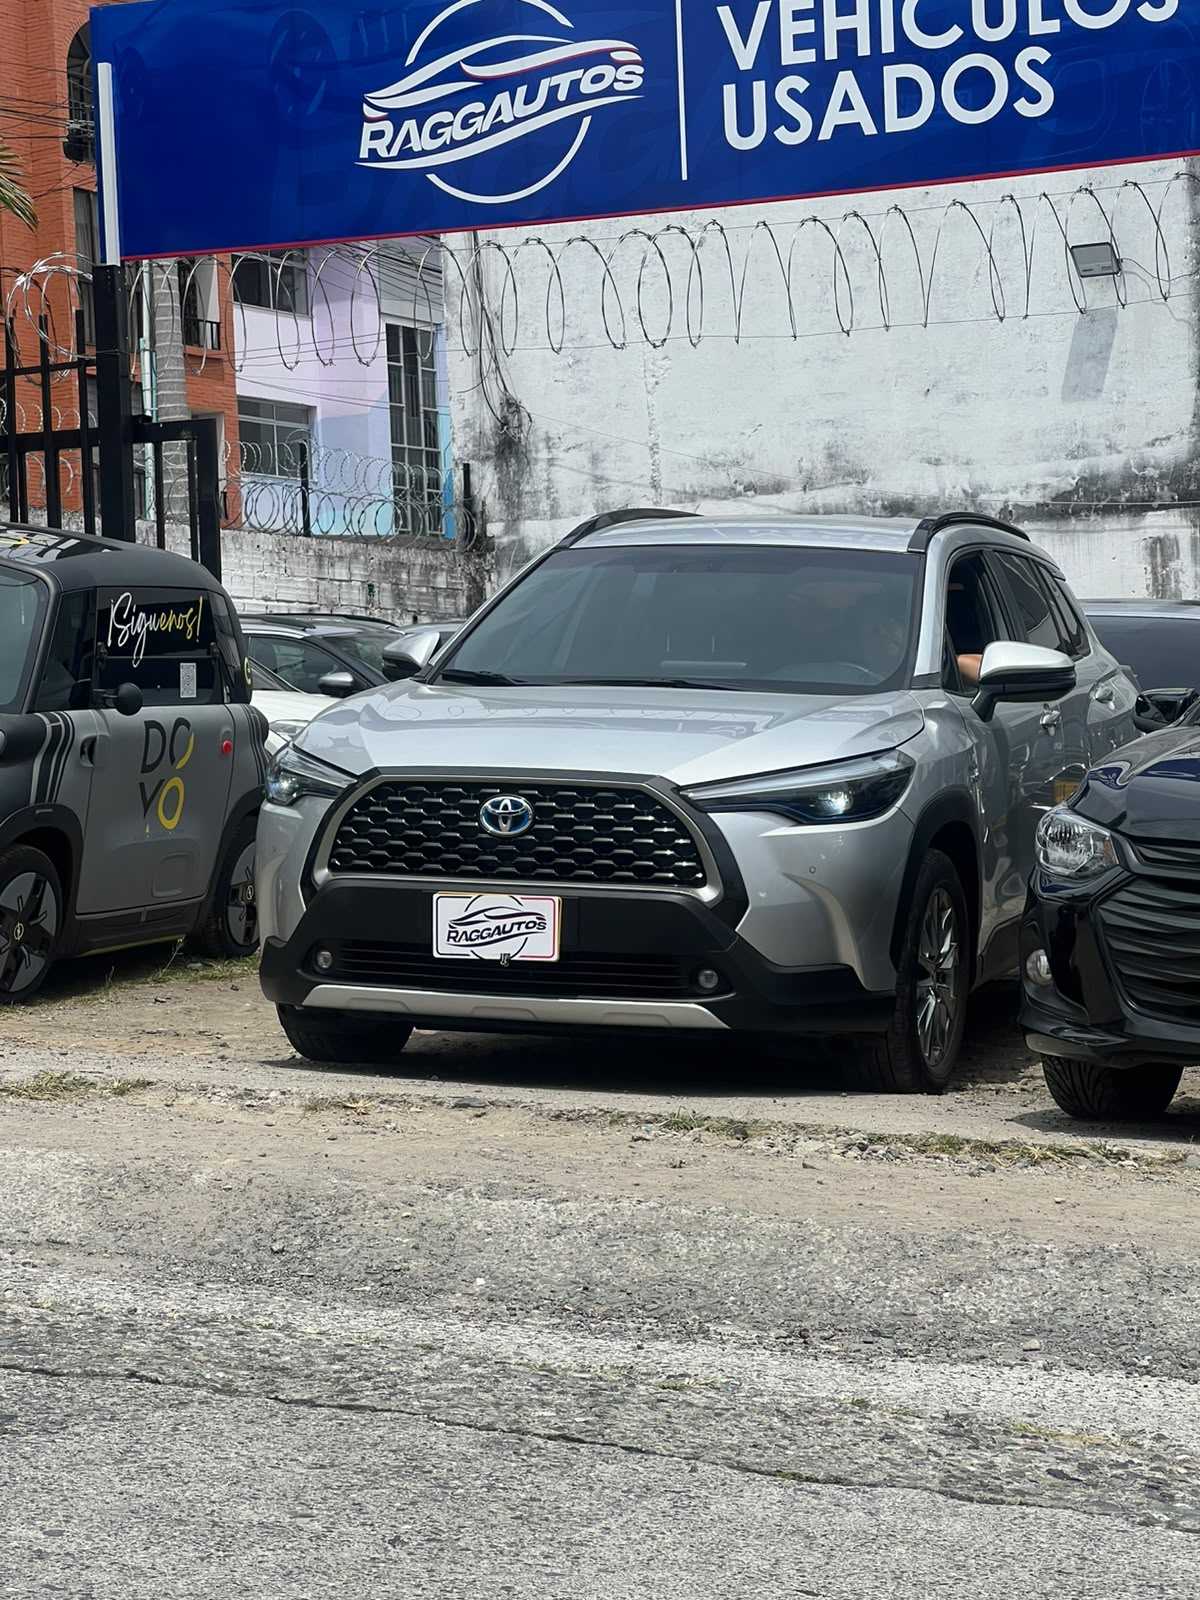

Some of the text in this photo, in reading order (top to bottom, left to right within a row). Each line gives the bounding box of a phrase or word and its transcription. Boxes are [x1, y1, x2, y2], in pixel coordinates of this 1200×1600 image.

[359, 64, 645, 159] RAGGAUTOS
[722, 46, 1055, 150] USADOS
[446, 920, 547, 943] RAGGAUTOS
